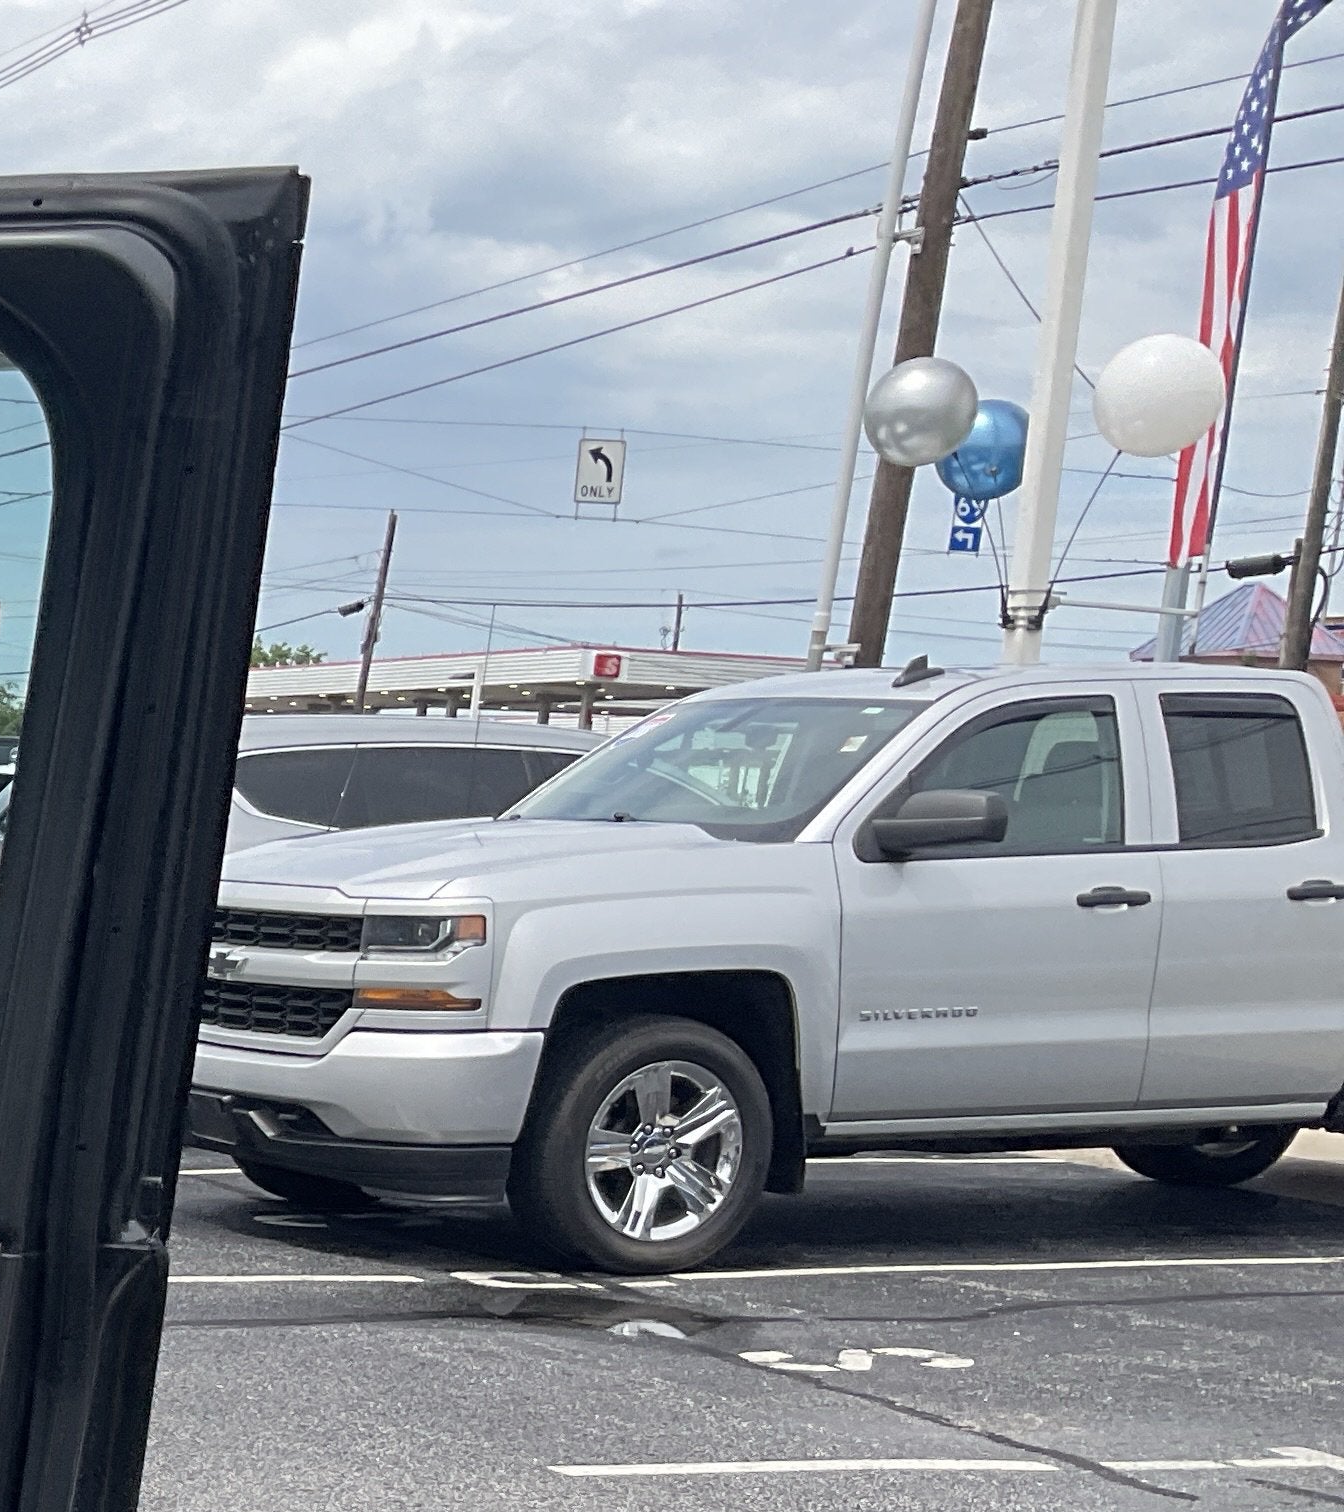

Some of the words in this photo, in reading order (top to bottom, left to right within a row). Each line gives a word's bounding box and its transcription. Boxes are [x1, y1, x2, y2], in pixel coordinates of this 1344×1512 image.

[580, 485, 615, 498] ONLY
[957, 497, 985, 517] 69
[859, 1005, 979, 1022] SILVERADO
